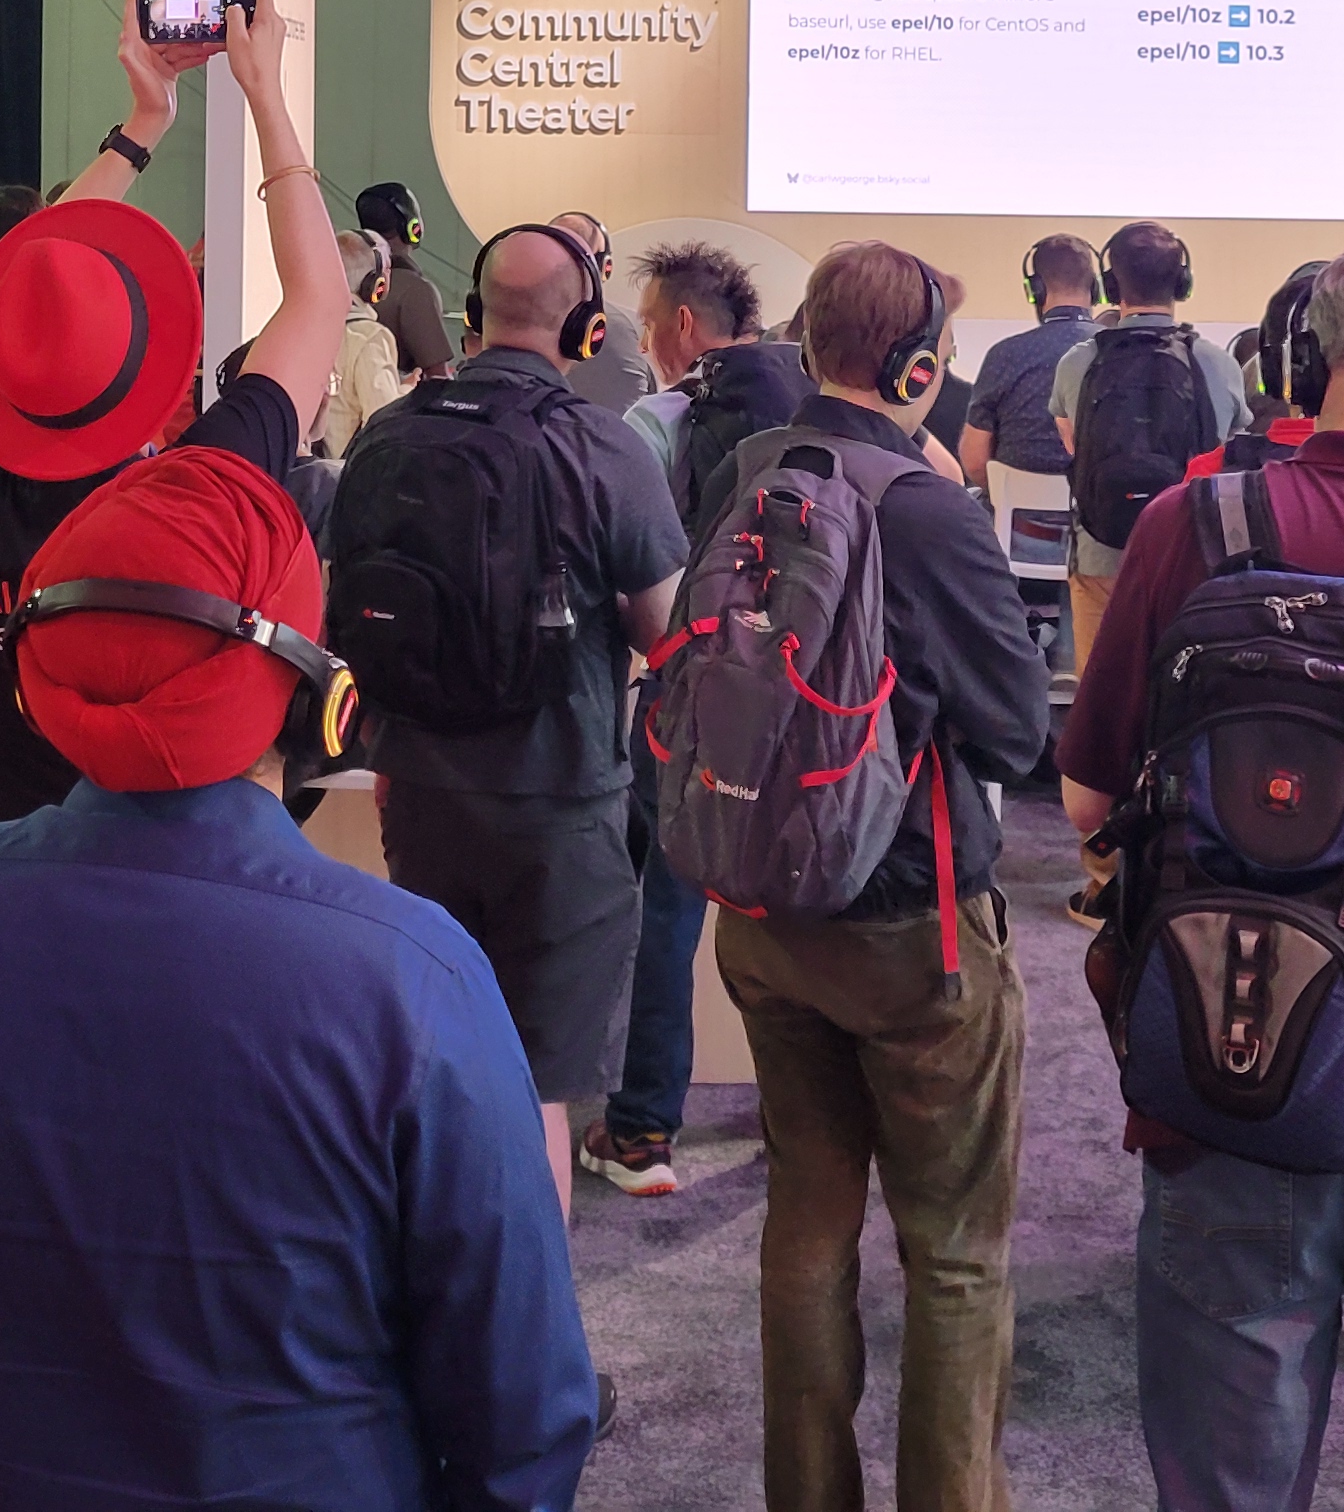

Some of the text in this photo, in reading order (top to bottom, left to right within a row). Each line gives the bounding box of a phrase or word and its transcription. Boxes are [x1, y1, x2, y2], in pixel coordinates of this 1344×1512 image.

[457, 0, 719, 51] Community
[788, 13, 1086, 33] baseurl, use epel/10 for CentOS and
[1137, 4, 1296, 27] epel/10z 10.2
[787, 43, 943, 62] epel/10z for RHEL.
[1137, 41, 1285, 64] epel/10 10.3
[457, 46, 623, 87] Central
[455, 92, 636, 134] Theater
[442, 400, 480, 411] Targus
